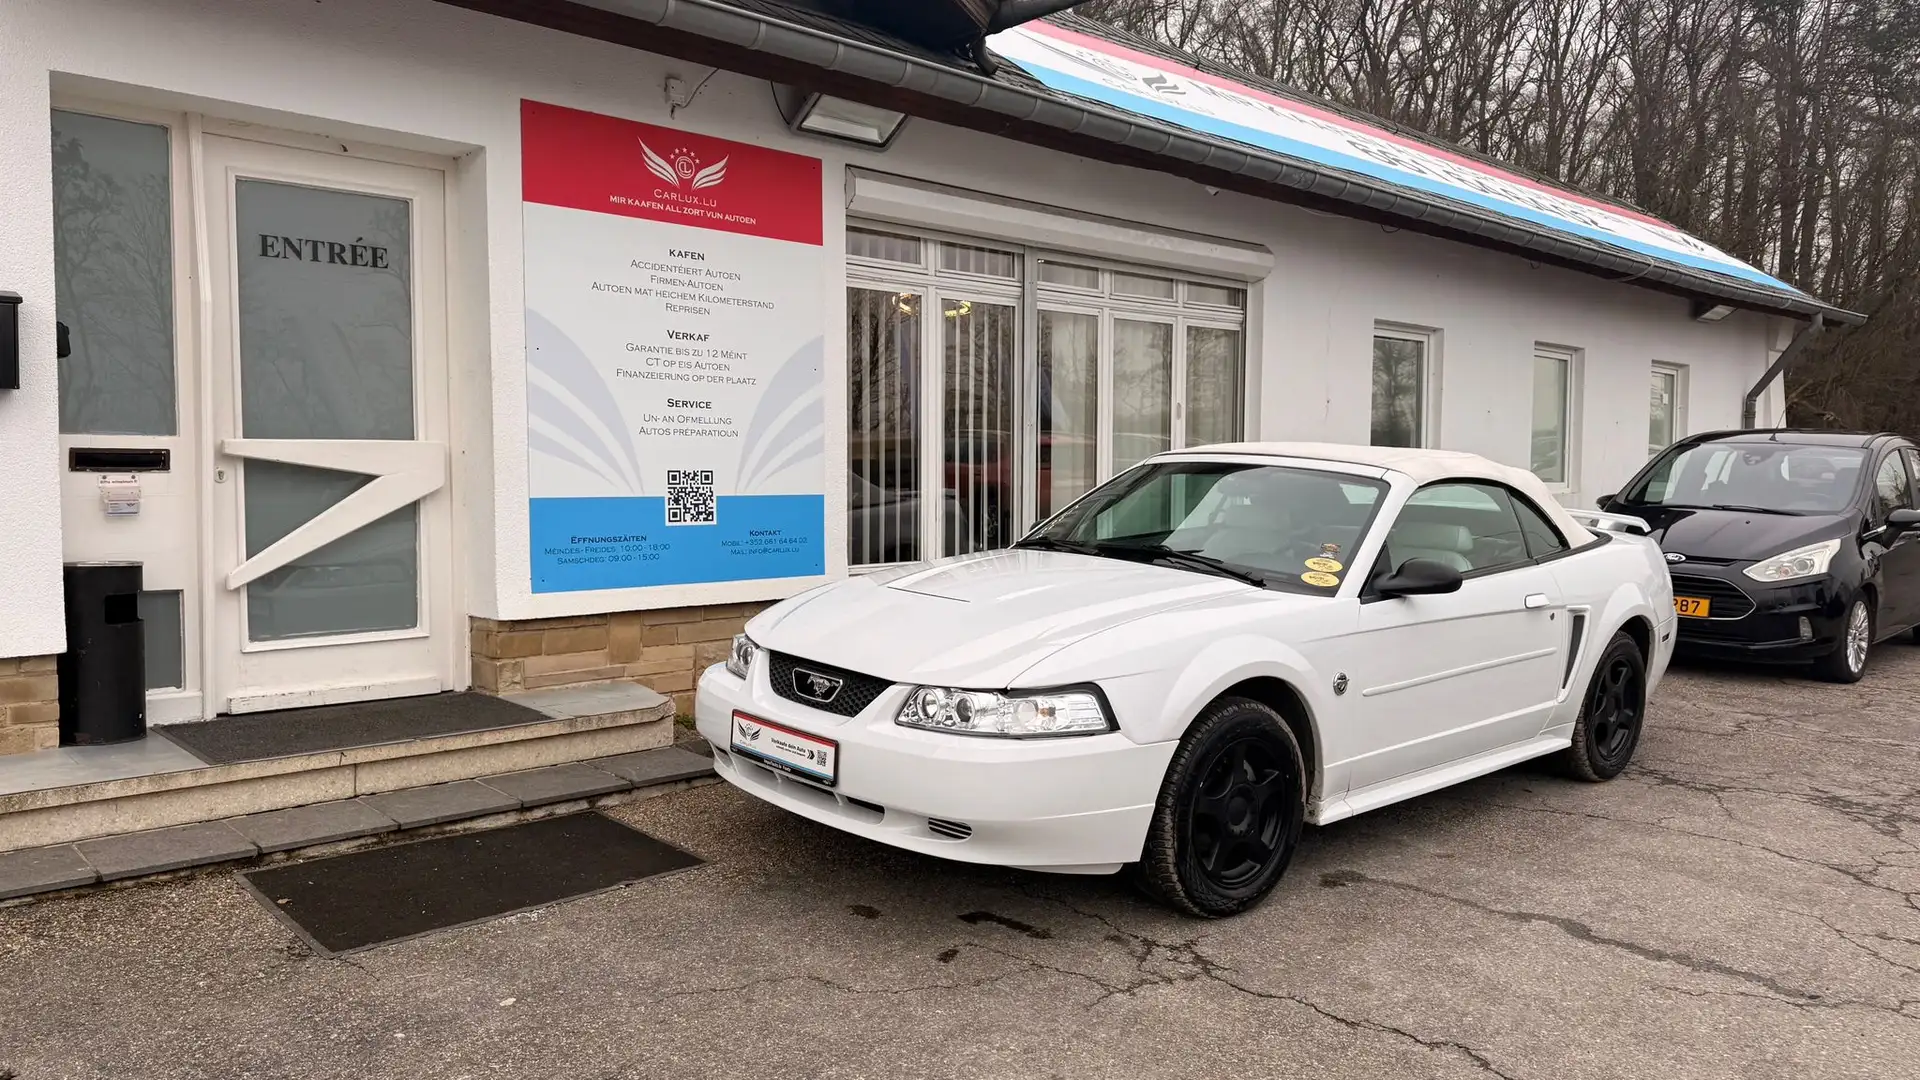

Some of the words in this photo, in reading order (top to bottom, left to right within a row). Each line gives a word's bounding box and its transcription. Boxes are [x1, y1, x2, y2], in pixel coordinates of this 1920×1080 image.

[653, 188, 717, 207] CARLUX.LU
[610, 195, 627, 204] MIR
[627, 197, 664, 210] KAAFEN
[665, 205, 682, 213] ALL
[683, 206, 705, 217] ZORT
[705, 210, 724, 219] VUN
[724, 214, 756, 225] AUTOEN
[259, 233, 389, 269] ENTRÉE
[669, 249, 705, 261] KAFEN
[630, 259, 703, 276] ACCIDENTÉIERT
[705, 268, 741, 281] AUTOEN
[650, 275, 724, 291] FIRMEN-AUTOEN
[591, 281, 632, 294] AUTOEN
[634, 287, 653, 296] MAT
[655, 290, 696, 301] HEICHEM
[698, 293, 775, 310] KILOMETERSTAND
[665, 302, 711, 315] REPRISEN
[666, 329, 710, 342] VERKAF
[625, 342, 673, 355] GARANTIE
[675, 347, 690, 356] BIS
[692, 348, 704, 357] ZU
[706, 349, 719, 358] 12
[720, 349, 748, 360] MÉINT
[645, 357, 661, 367] CT
[662, 360, 677, 368] OP
[694, 361, 731, 371] AUTOEN
[616, 368, 690, 382] FINANZEIERUNG
[691, 374, 705, 382] OP
[706, 375, 724, 384] DER
[726, 376, 757, 386] PLAATZ
[666, 398, 712, 409] SERVICE
[643, 413, 660, 422] UN-
[661, 415, 675, 423] AN
[676, 414, 732, 425] OFMELLUNG
[638, 426, 671, 436] AUTOS
